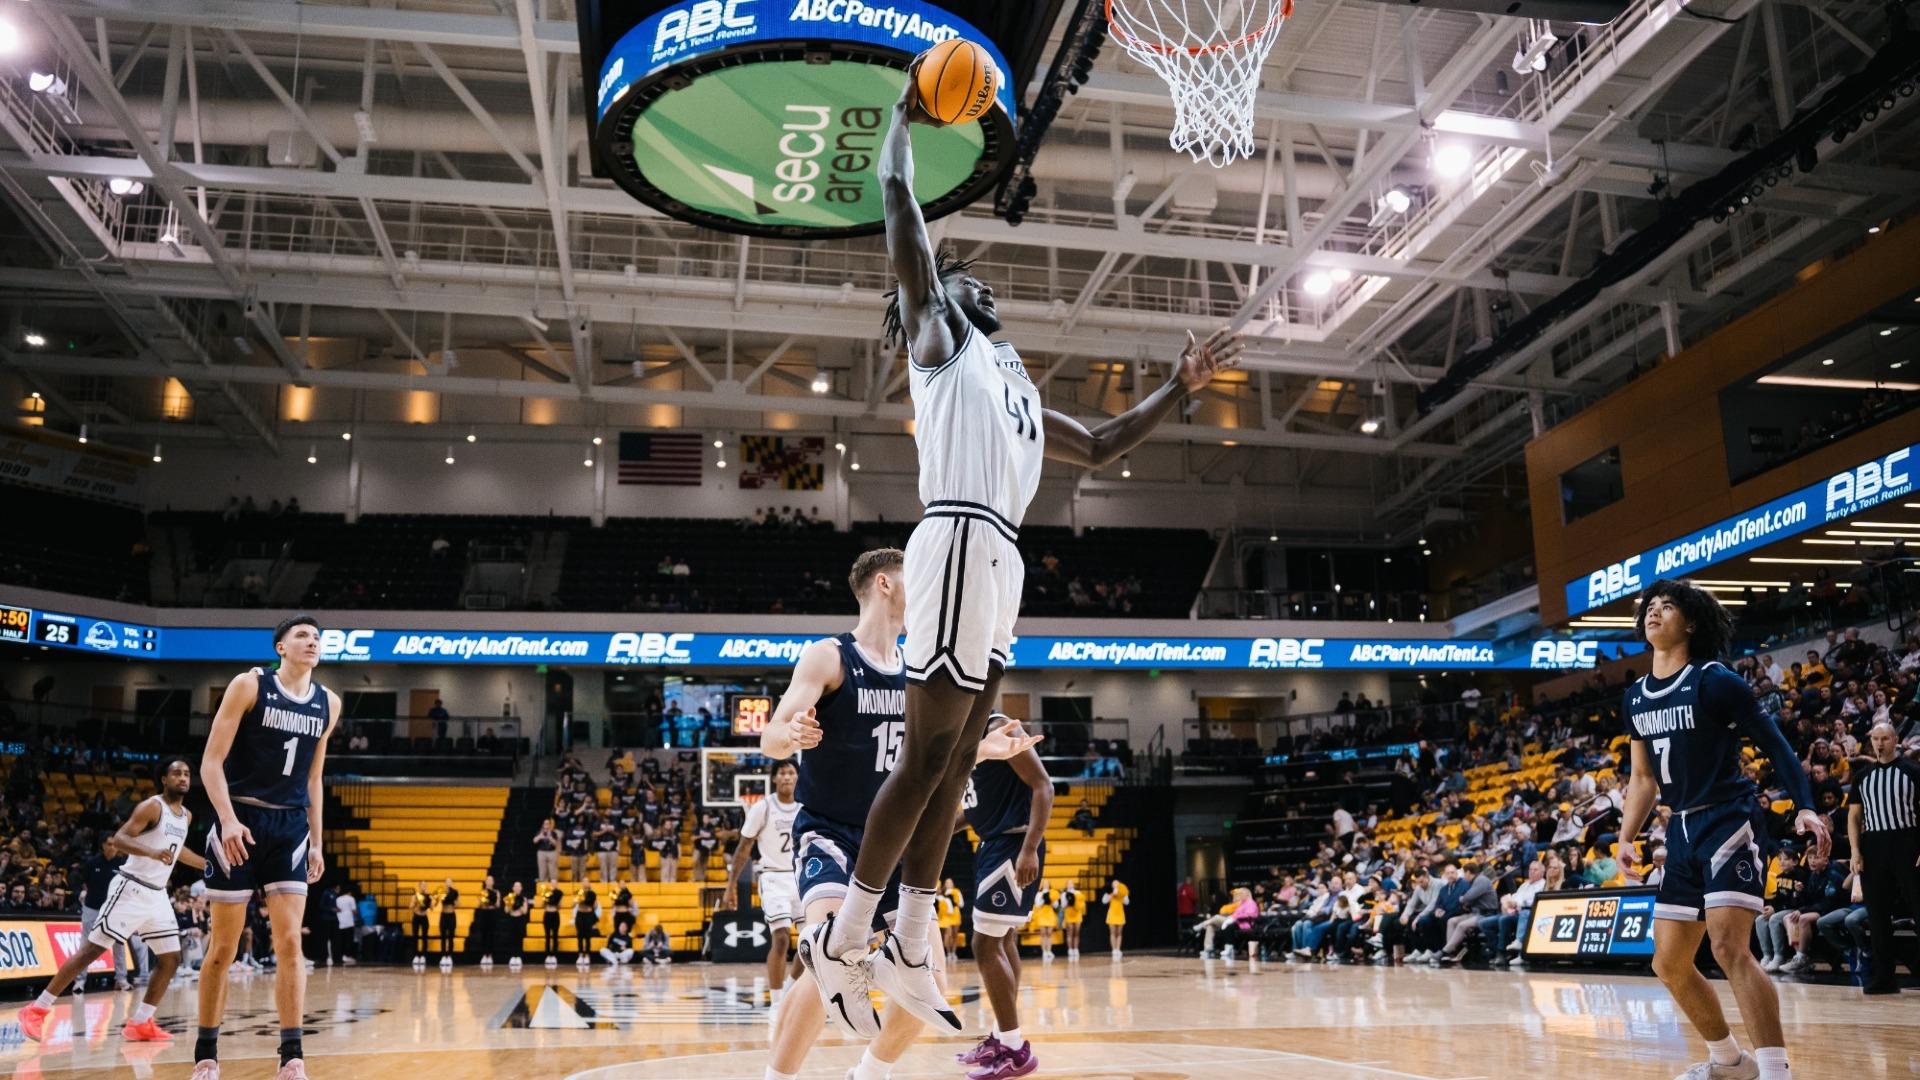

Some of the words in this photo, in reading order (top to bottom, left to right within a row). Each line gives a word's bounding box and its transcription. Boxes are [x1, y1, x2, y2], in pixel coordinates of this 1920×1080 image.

[653, 0, 757, 52] ABC
[789, 0, 967, 42] ABCPartyAndT
[651, 44, 678, 63] Party
[679, 43, 687, 51] &
[690, 34, 714, 47] Tent
[716, 26, 757, 40] Rental
[966, 64, 992, 117] Wilson
[772, 104, 831, 203] secu
[825, 106, 883, 203] arena
[1003, 381, 1037, 441] 41
[1826, 447, 1910, 511] ABC
[1825, 507, 1849, 521] Party
[1850, 503, 1857, 512] &
[1859, 495, 1879, 509] Tent
[1881, 482, 1912, 501] Rental
[1655, 501, 1807, 575] ABCPartyAndTent.com
[1588, 555, 1641, 601] ABC
[3, 629, 24, 639] HALF
[45, 624, 70, 643] 25
[321, 630, 375, 654] BC
[392, 635, 589, 660] ABCPartyAndTent.com
[607, 633, 694, 657] ABC
[605, 656, 629, 665] Party
[1048, 642, 1227, 664] ABCPartyAndTent.com
[1249, 639, 1325, 661] ABC
[1531, 641, 1598, 662] ABC
[1249, 660, 1270, 669] Party
[262, 706, 324, 738] MONMOUTH
[739, 711, 766, 733] 20
[1631, 704, 1695, 737] MONMOUTH
[282, 736, 299, 776] 1
[871, 721, 906, 772] 15
[1652, 737, 1673, 785] 7
[780, 832, 790, 853] 2
[1585, 920, 1597, 928] 2ND
[1597, 919, 1612, 928] HALF
[1588, 901, 1617, 918] 19:50
[1556, 917, 1576, 938] 22
[1584, 932, 1590, 942] 3
[1601, 932, 1607, 942] 3
[1621, 916, 1643, 938] 25
[0, 930, 39, 969] SOR
